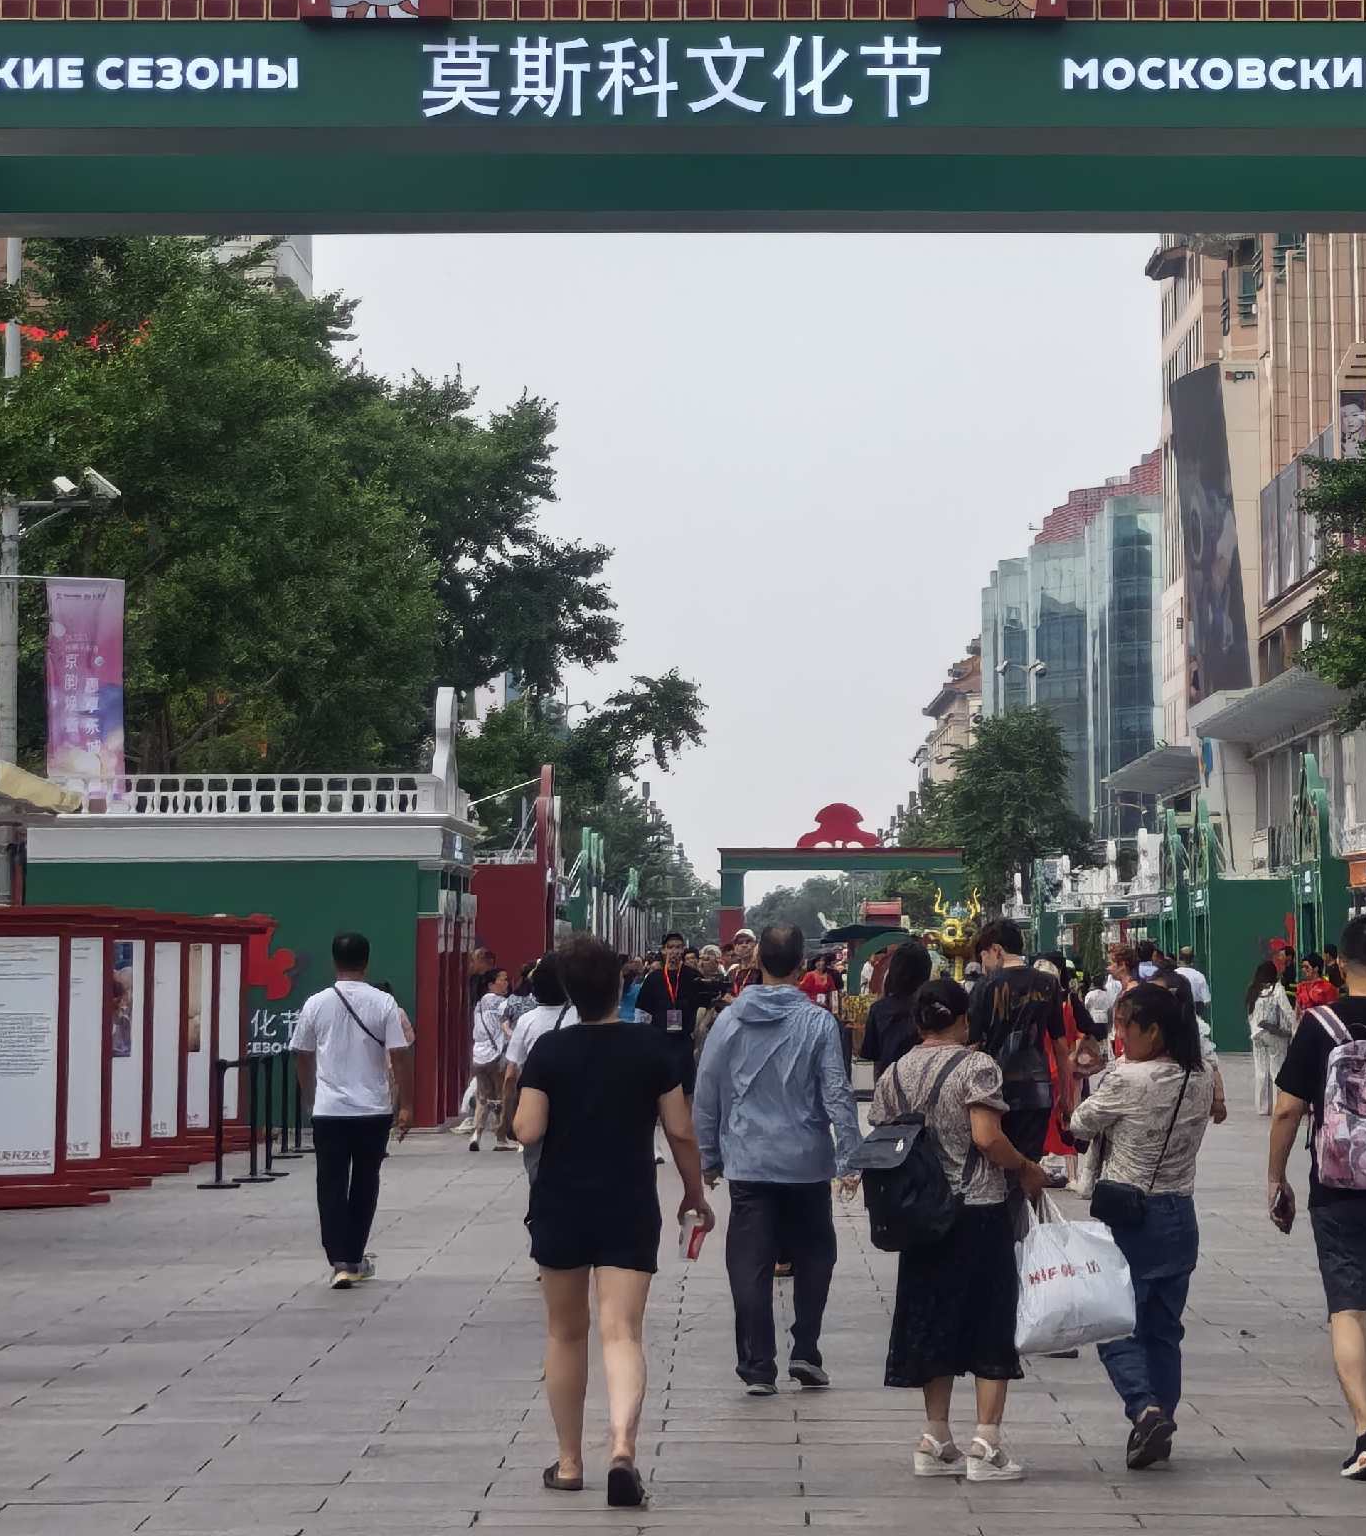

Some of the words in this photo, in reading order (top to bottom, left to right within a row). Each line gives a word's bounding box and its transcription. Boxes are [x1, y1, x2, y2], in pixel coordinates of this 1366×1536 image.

[96, 56, 299, 90] СЕЗОНЫ
[421, 34, 943, 119] 莫斯科文化节
